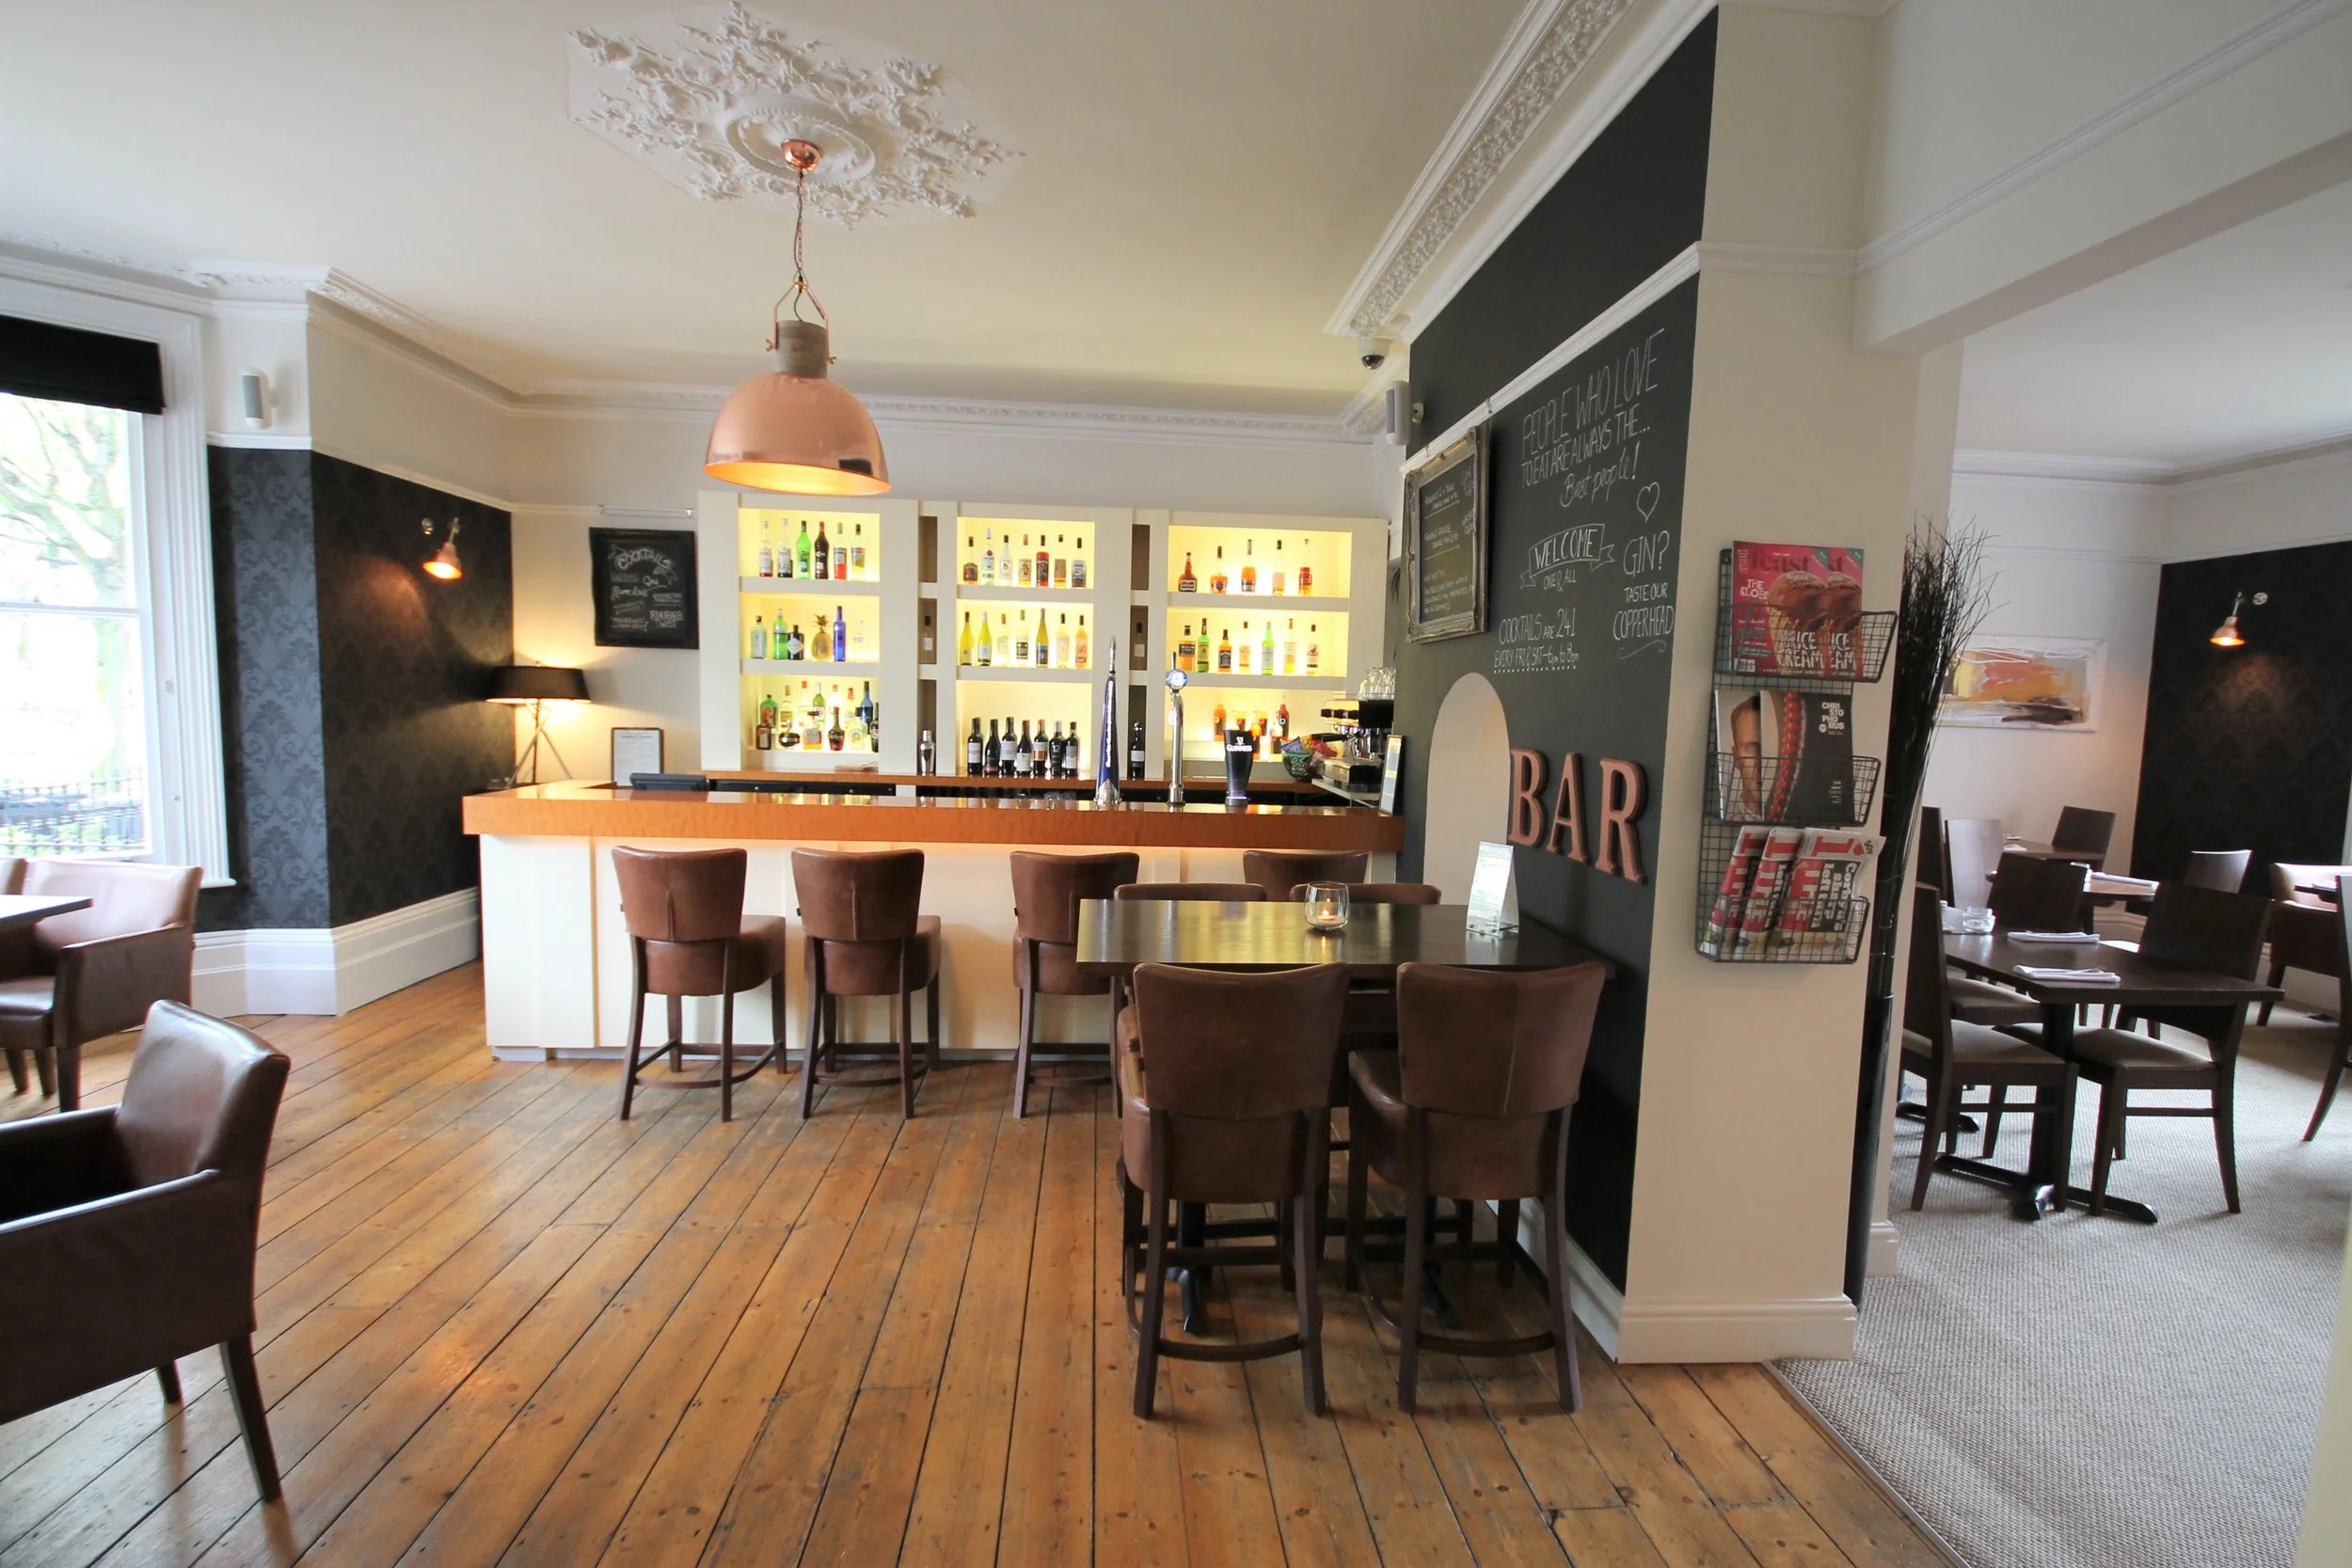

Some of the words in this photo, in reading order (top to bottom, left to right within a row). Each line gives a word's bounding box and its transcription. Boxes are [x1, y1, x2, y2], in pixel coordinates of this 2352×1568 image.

[1521, 387, 1572, 460] PEOPLE
[1577, 365, 1611, 430] WHO
[1613, 327, 1665, 410] LOVE
[1520, 459, 1533, 489] TO
[1533, 451, 1551, 485] EAT
[1550, 438, 1572, 476] ARE
[1571, 419, 1612, 467] ALWAYS
[1534, 529, 1598, 569] WELCOME
[1623, 530, 1671, 578] GIN?
[1543, 570, 1557, 591] ONE
[1565, 567, 1578, 585] ALL
[1624, 583, 1649, 604] TASTE
[1650, 582, 1668, 600] OUR
[1499, 613, 1542, 645] COCKTAILS
[1556, 607, 1576, 638] 241
[1507, 747, 1647, 885] BAR
[1823, 872, 1843, 920] sharp
[1834, 862, 1858, 931] Corbyn's
